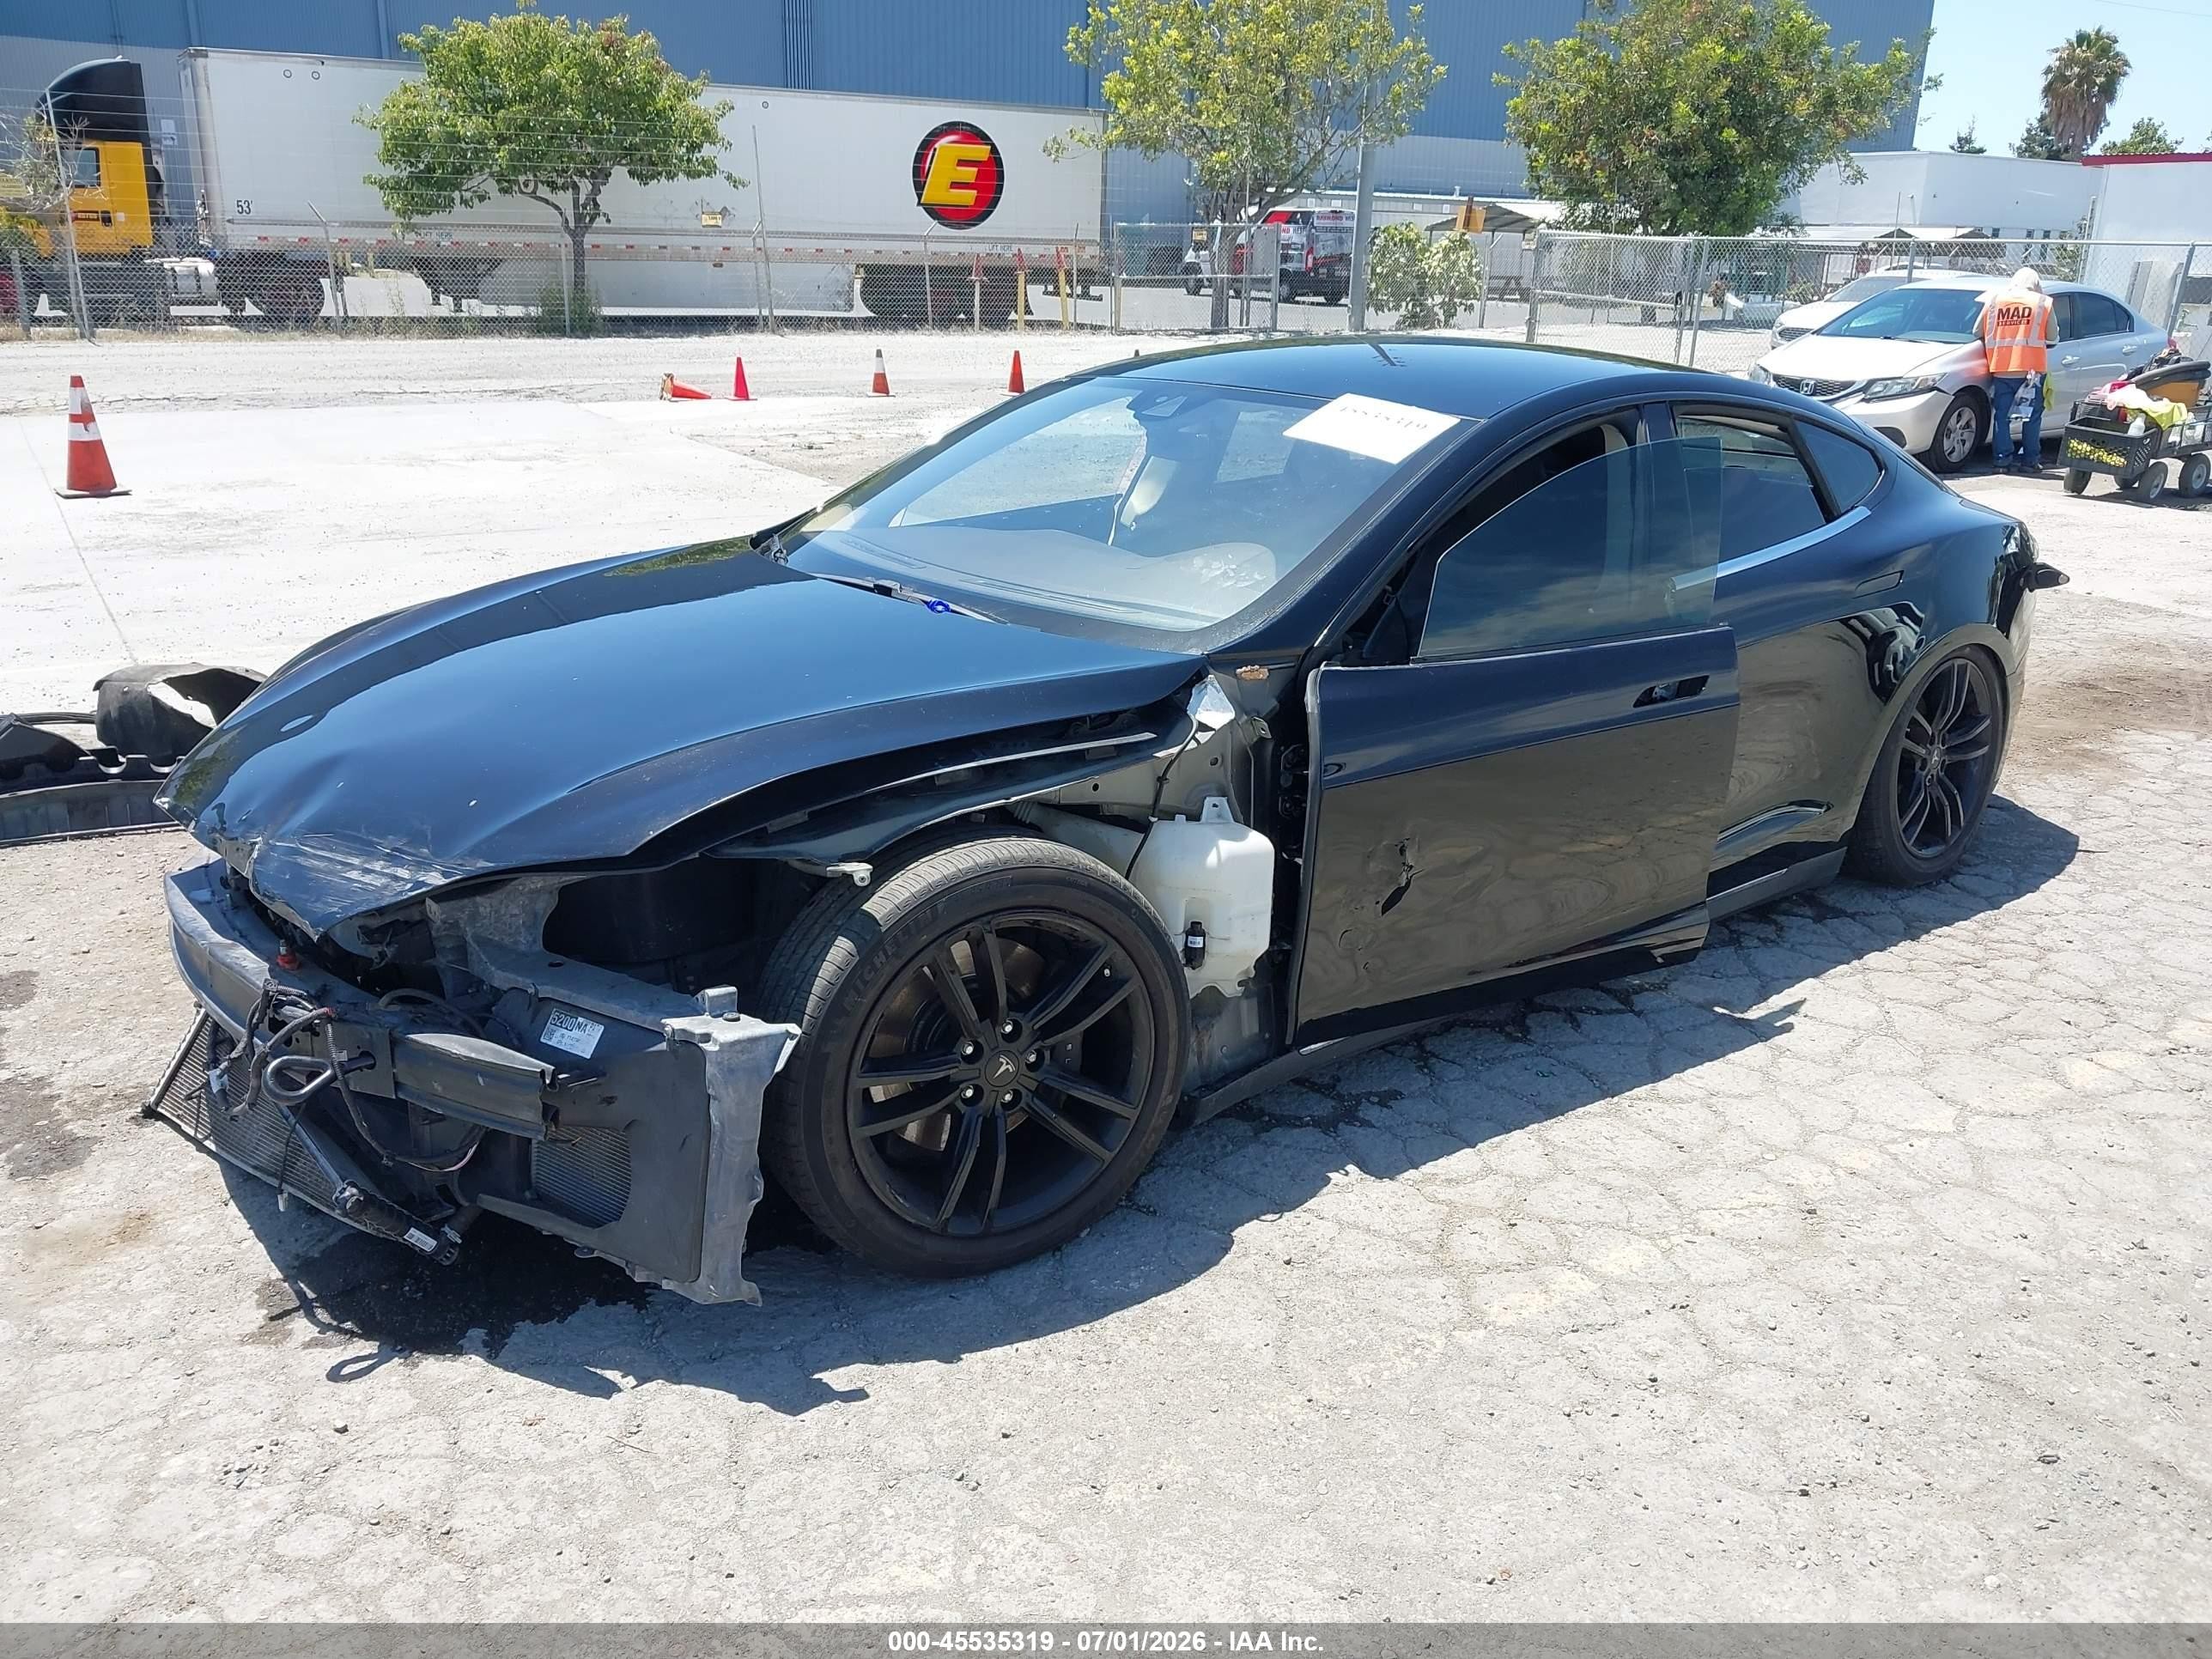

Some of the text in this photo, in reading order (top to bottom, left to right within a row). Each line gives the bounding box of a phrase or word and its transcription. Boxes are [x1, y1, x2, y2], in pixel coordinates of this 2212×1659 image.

[921, 143, 991, 206] E
[236, 200, 252, 214] 53'
[1997, 307, 2033, 320] MAD
[550, 1012, 577, 1030] 5200
